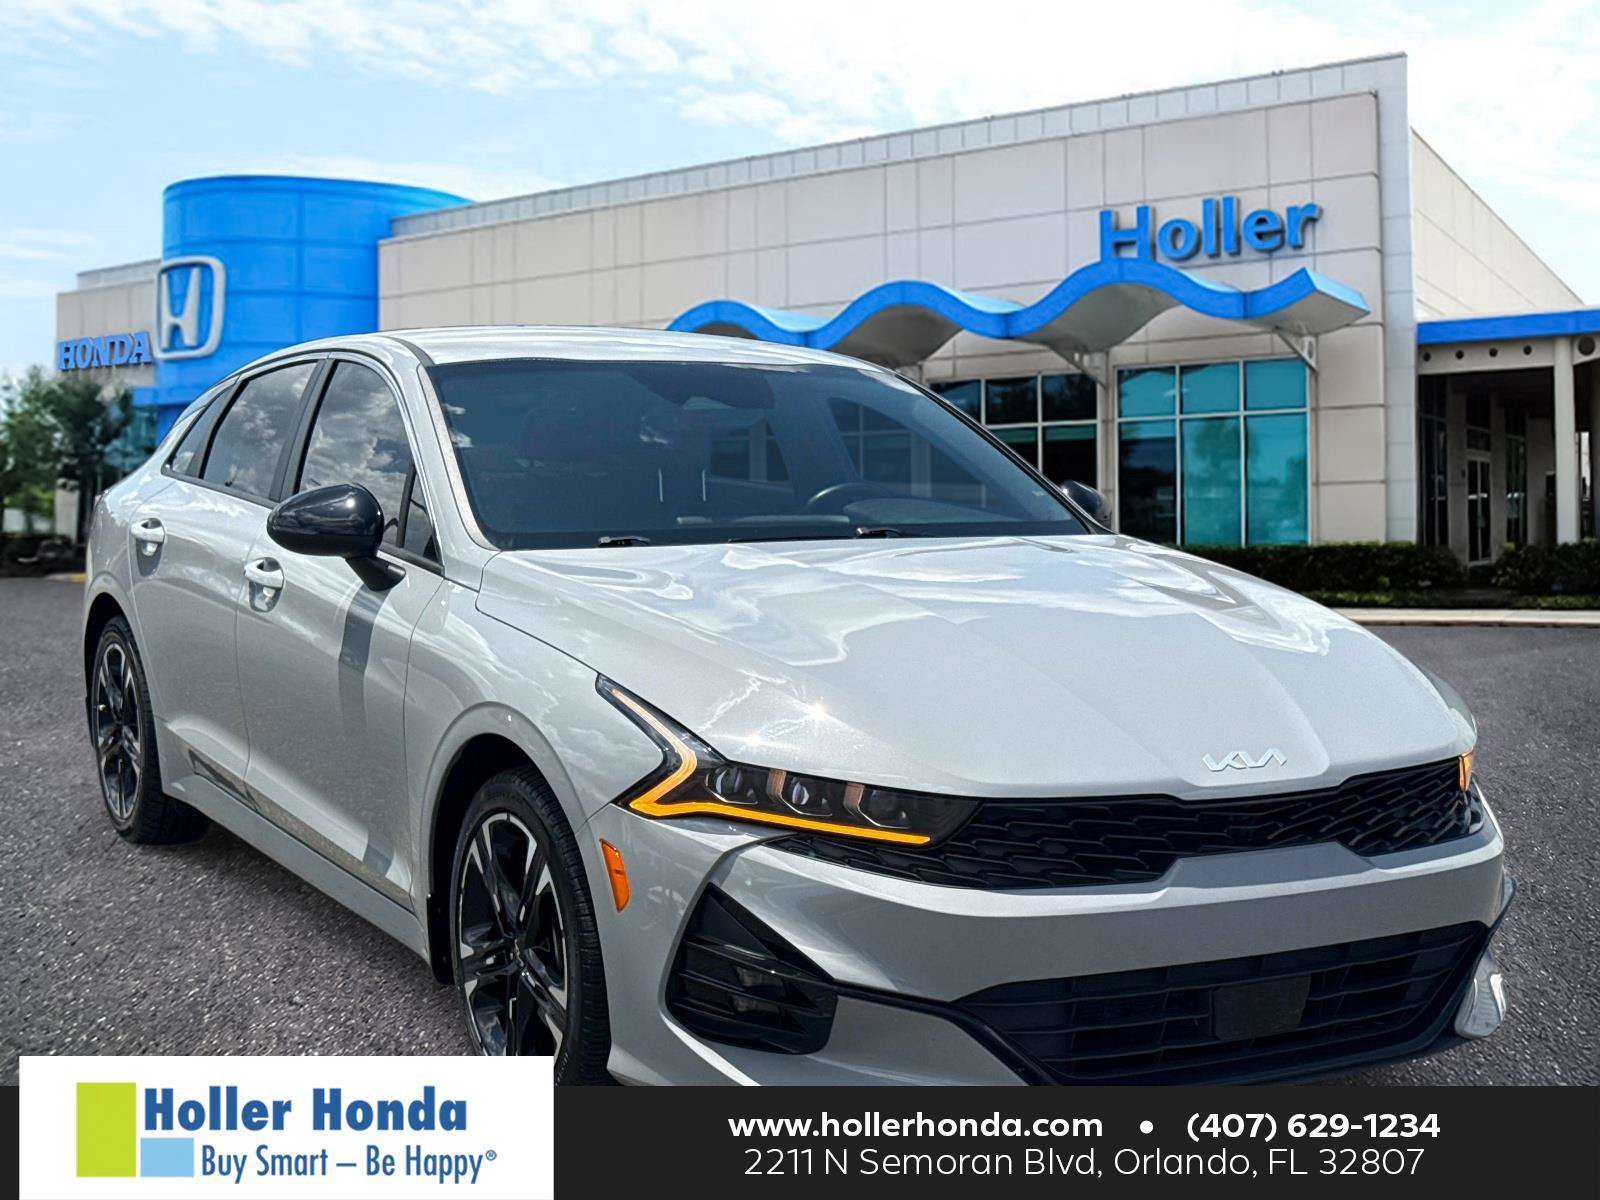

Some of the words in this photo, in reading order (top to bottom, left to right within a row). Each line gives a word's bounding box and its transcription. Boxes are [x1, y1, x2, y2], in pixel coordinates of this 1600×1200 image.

[1099, 195, 1322, 262] Holler
[57, 331, 153, 371] HONDA
[1202, 748, 1287, 772] KIA
